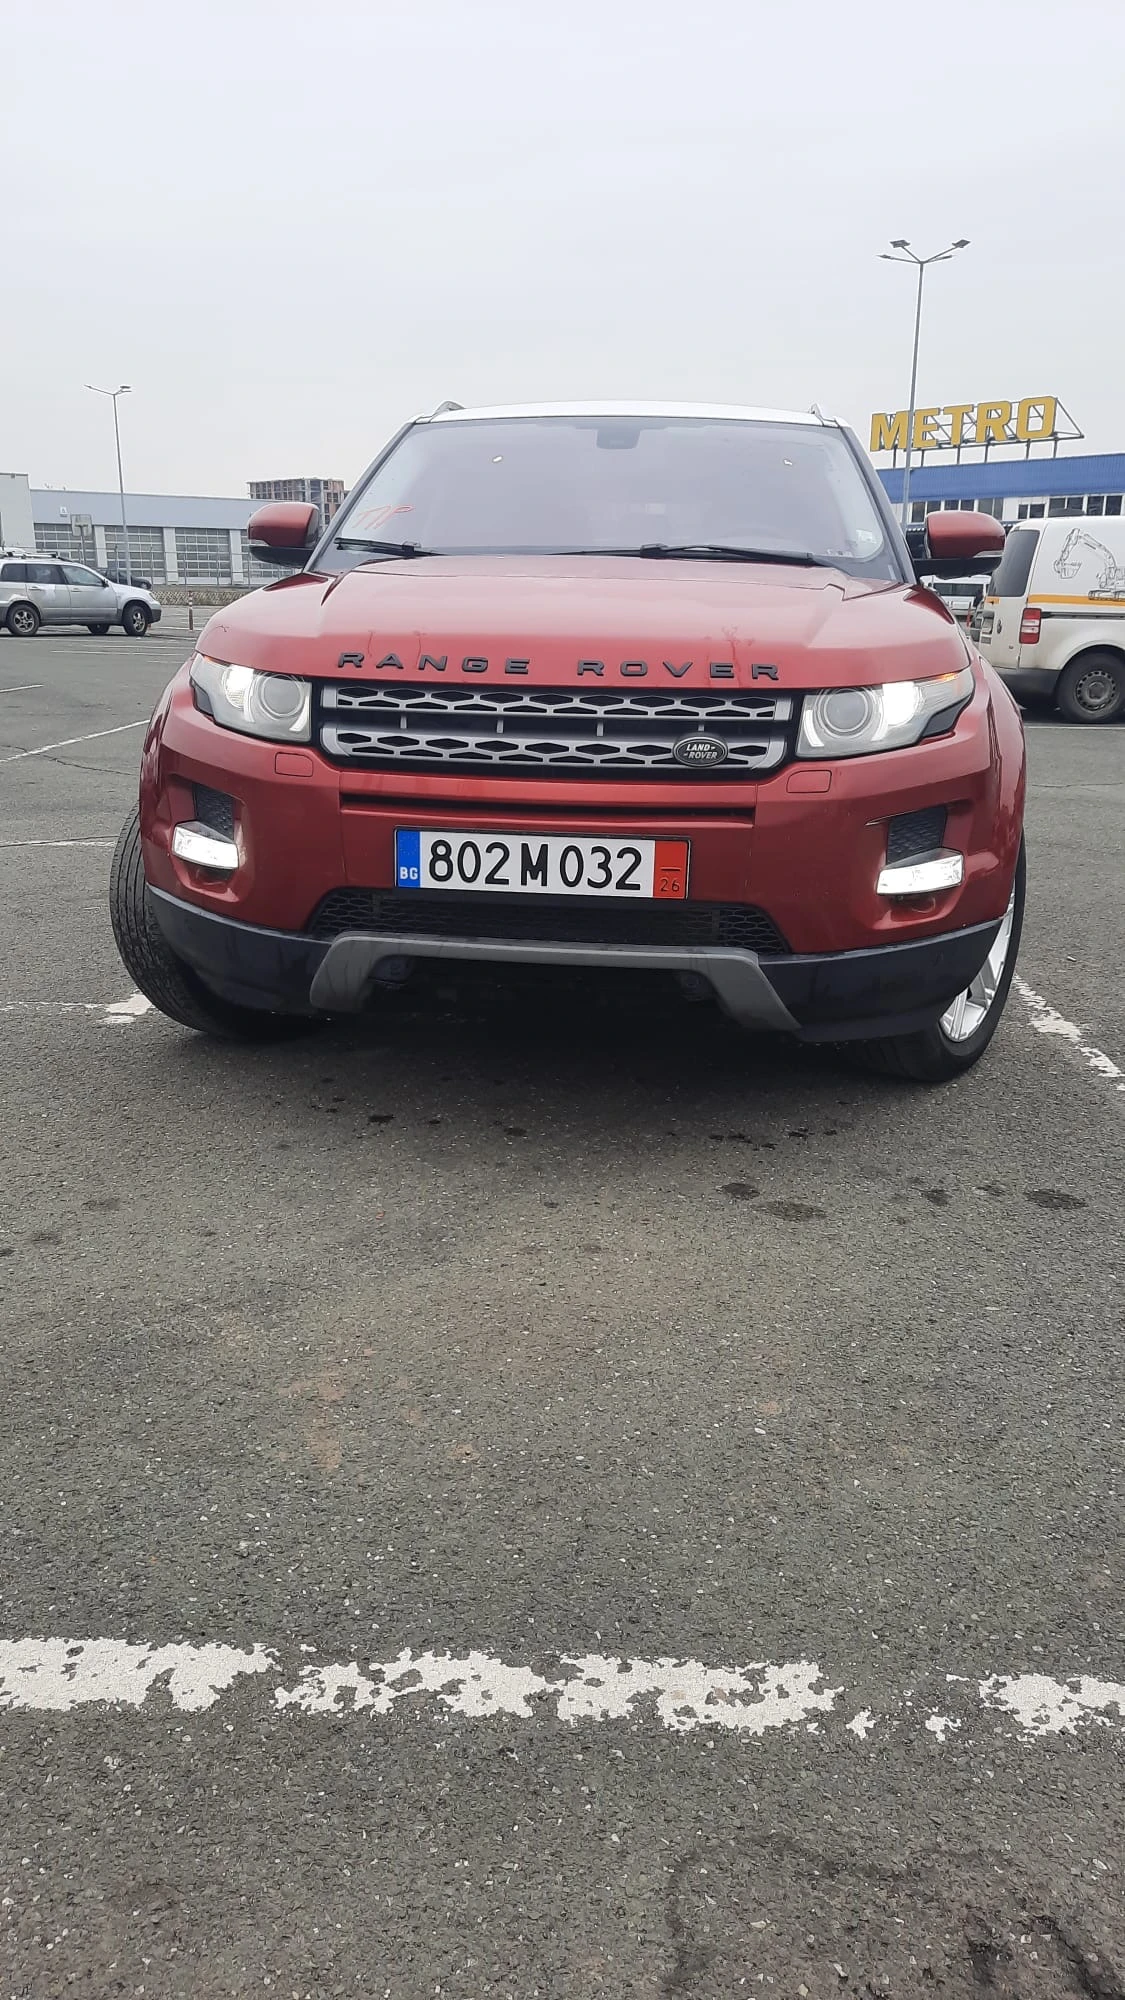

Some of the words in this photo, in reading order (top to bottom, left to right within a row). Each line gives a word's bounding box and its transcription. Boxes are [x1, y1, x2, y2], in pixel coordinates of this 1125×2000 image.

[870, 395, 1057, 451] METRO
[337, 652, 531, 674] RANGE
[577, 659, 779, 680] ROVER
[400, 866, 418, 880] BG
[429, 839, 510, 885] 802
[520, 842, 549, 887] M
[560, 845, 642, 891] 032
[660, 877, 680, 893] 26
